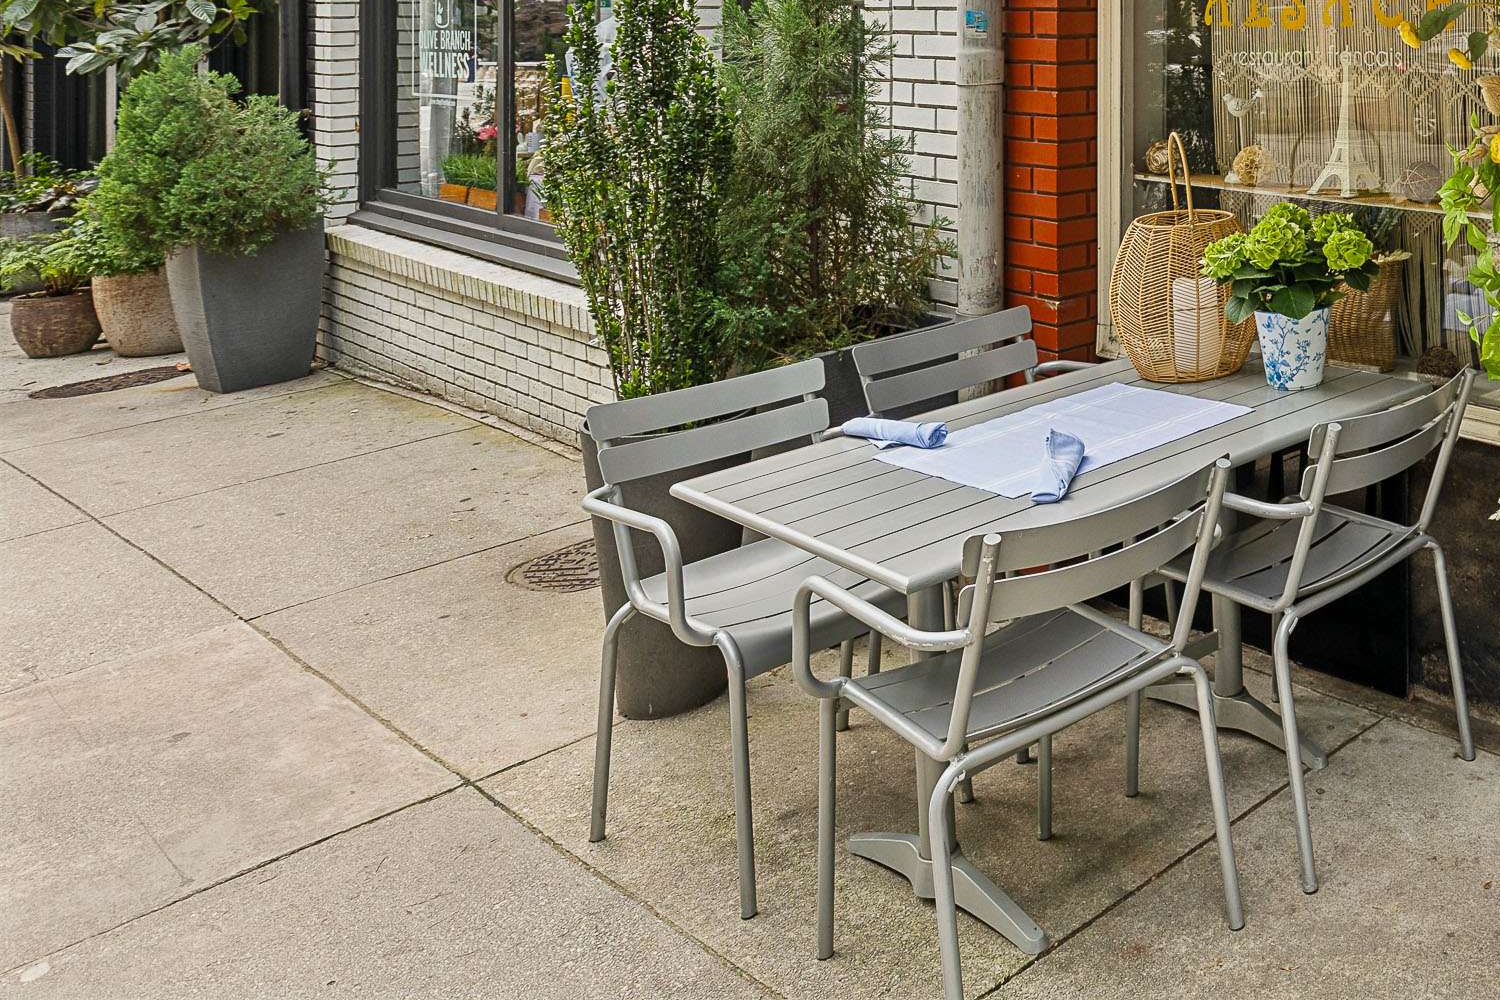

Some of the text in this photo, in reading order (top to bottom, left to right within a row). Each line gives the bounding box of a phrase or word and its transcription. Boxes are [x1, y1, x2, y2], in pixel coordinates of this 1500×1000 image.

[419, 30, 471, 51] OLIVE BRANCH
[420, 51, 470, 82] WELLNESS
